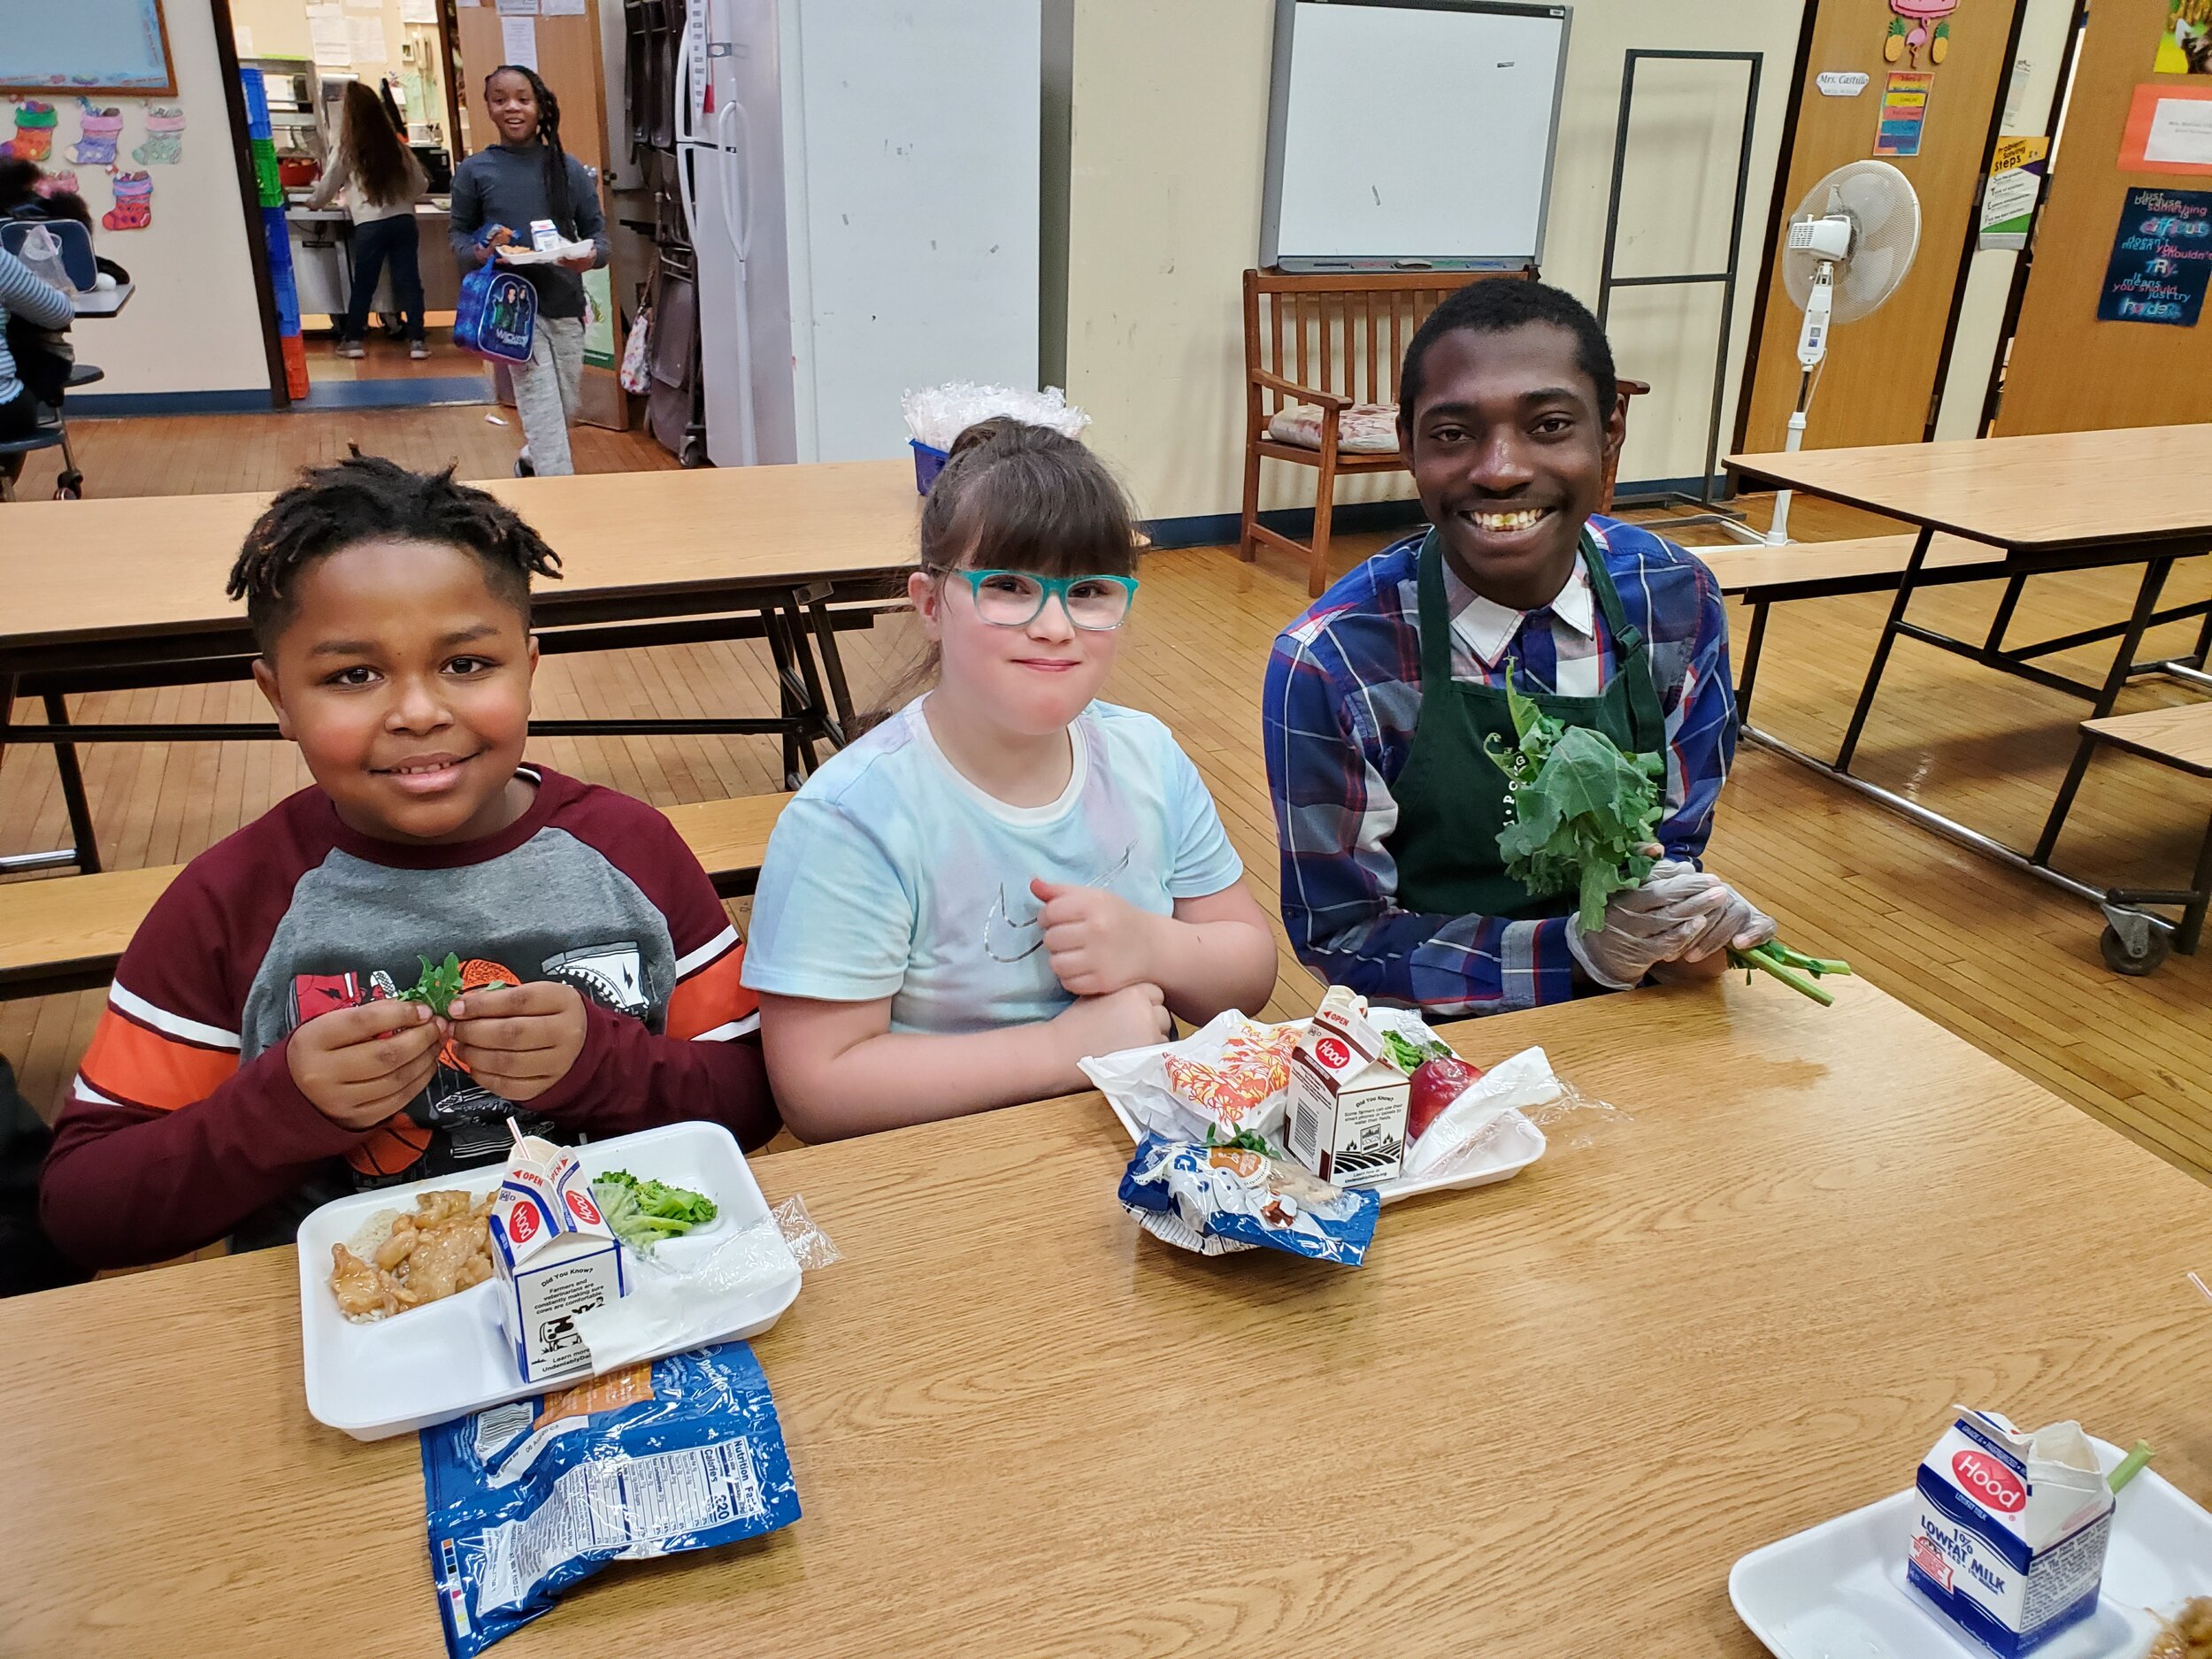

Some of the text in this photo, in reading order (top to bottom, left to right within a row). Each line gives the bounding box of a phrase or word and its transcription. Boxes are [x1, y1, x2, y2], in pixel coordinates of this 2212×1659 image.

[1818, 74, 1868, 86] Mrs. Castillo
[1993, 155, 2023, 173] Steps
[2134, 196, 2182, 207] because
[2141, 190, 2164, 200] Just
[2147, 204, 2208, 217] something
[2128, 234, 2170, 245] doesn't
[2122, 242, 2177, 254] mean you
[2113, 283, 2178, 295] you should
[2123, 278, 2162, 288] means
[2147, 291, 2192, 303] just try
[1331, 1013, 1350, 1027] OPEN
[1318, 1041, 1348, 1067] Hood
[522, 1171, 544, 1187] OPEN
[570, 1192, 596, 1223] Hood
[513, 1204, 536, 1241] Hood
[541, 1277, 554, 1287] Did
[554, 1271, 569, 1280] You
[543, 1286, 583, 1301] veterinarians
[549, 1281, 575, 1294] Farmers
[534, 1296, 567, 1310] constantly
[567, 1289, 591, 1301] making
[535, 1306, 553, 1315] cows
[565, 1292, 603, 1307] comfortable.
[552, 1348, 590, 1363] Learn more
[704, 1448, 718, 1483] Calories
[733, 1440, 749, 1481] Nutrition
[1957, 1454, 2022, 1509] Hood
[1953, 1528, 1974, 1555] 1%
[1920, 1513, 1968, 1563] LOWFAT
[1970, 1557, 2006, 1594] MILK
